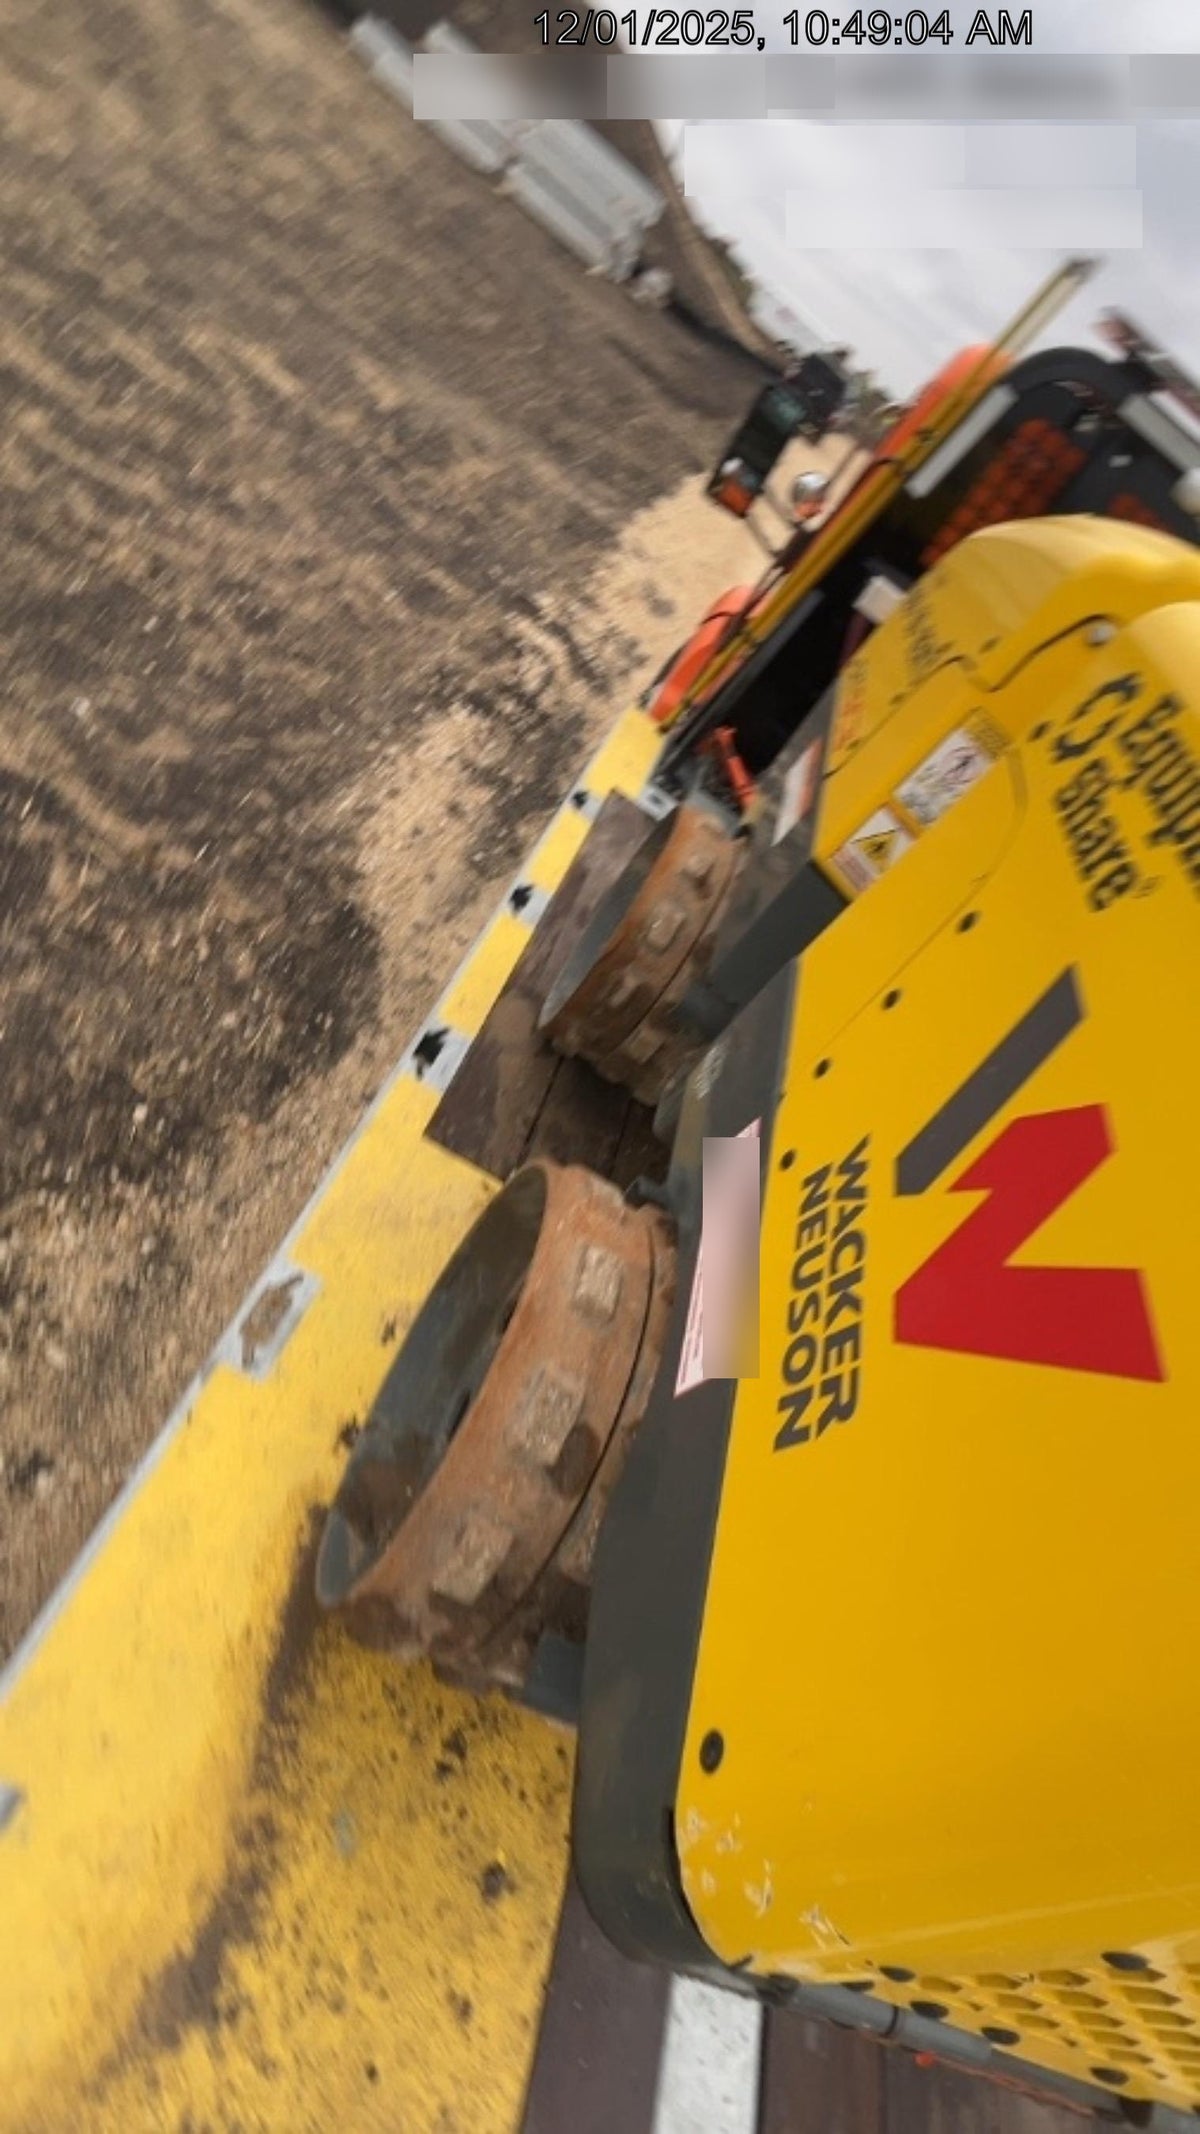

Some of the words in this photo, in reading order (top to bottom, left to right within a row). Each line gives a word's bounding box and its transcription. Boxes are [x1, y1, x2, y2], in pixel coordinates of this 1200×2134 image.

[1054, 757, 1140, 912] Share
[772, 1162, 833, 1453] NEUSON
[815, 1133, 871, 1440] WACKER
